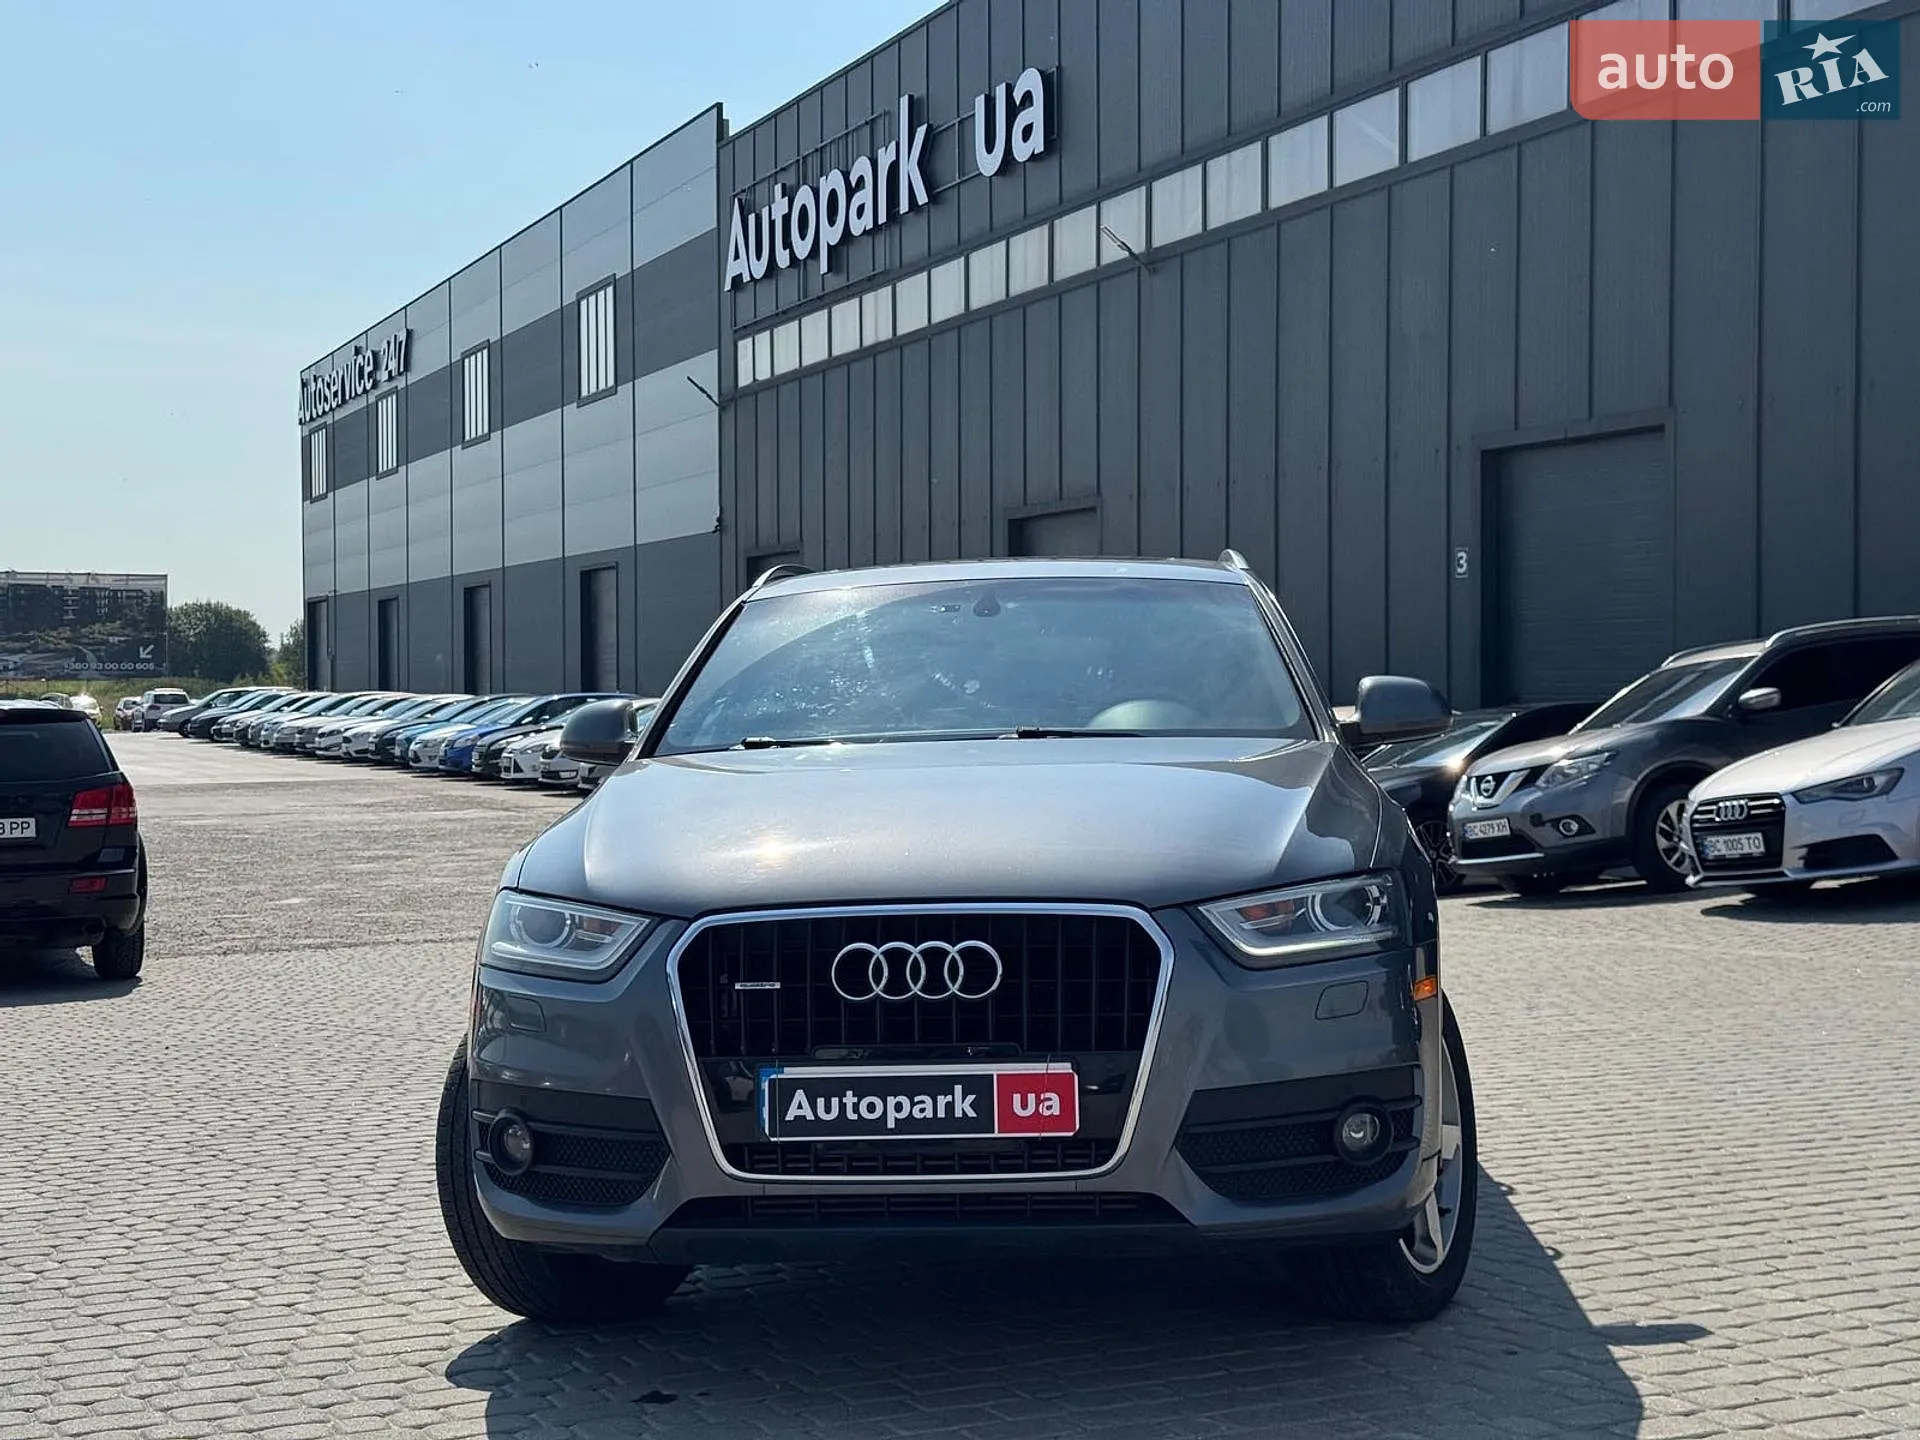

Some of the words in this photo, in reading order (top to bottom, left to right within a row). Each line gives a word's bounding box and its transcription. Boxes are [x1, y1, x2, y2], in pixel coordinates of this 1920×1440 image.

[723, 93, 930, 292] Autopark
[974, 66, 1045, 178] ua
[298, 345, 375, 425] Autoservice
[1456, 551, 1468, 574] 3
[10, 821, 31, 835] PP
[1744, 836, 1762, 850] TO
[784, 1085, 978, 1129] Autopark
[1012, 1090, 1061, 1117] ua
